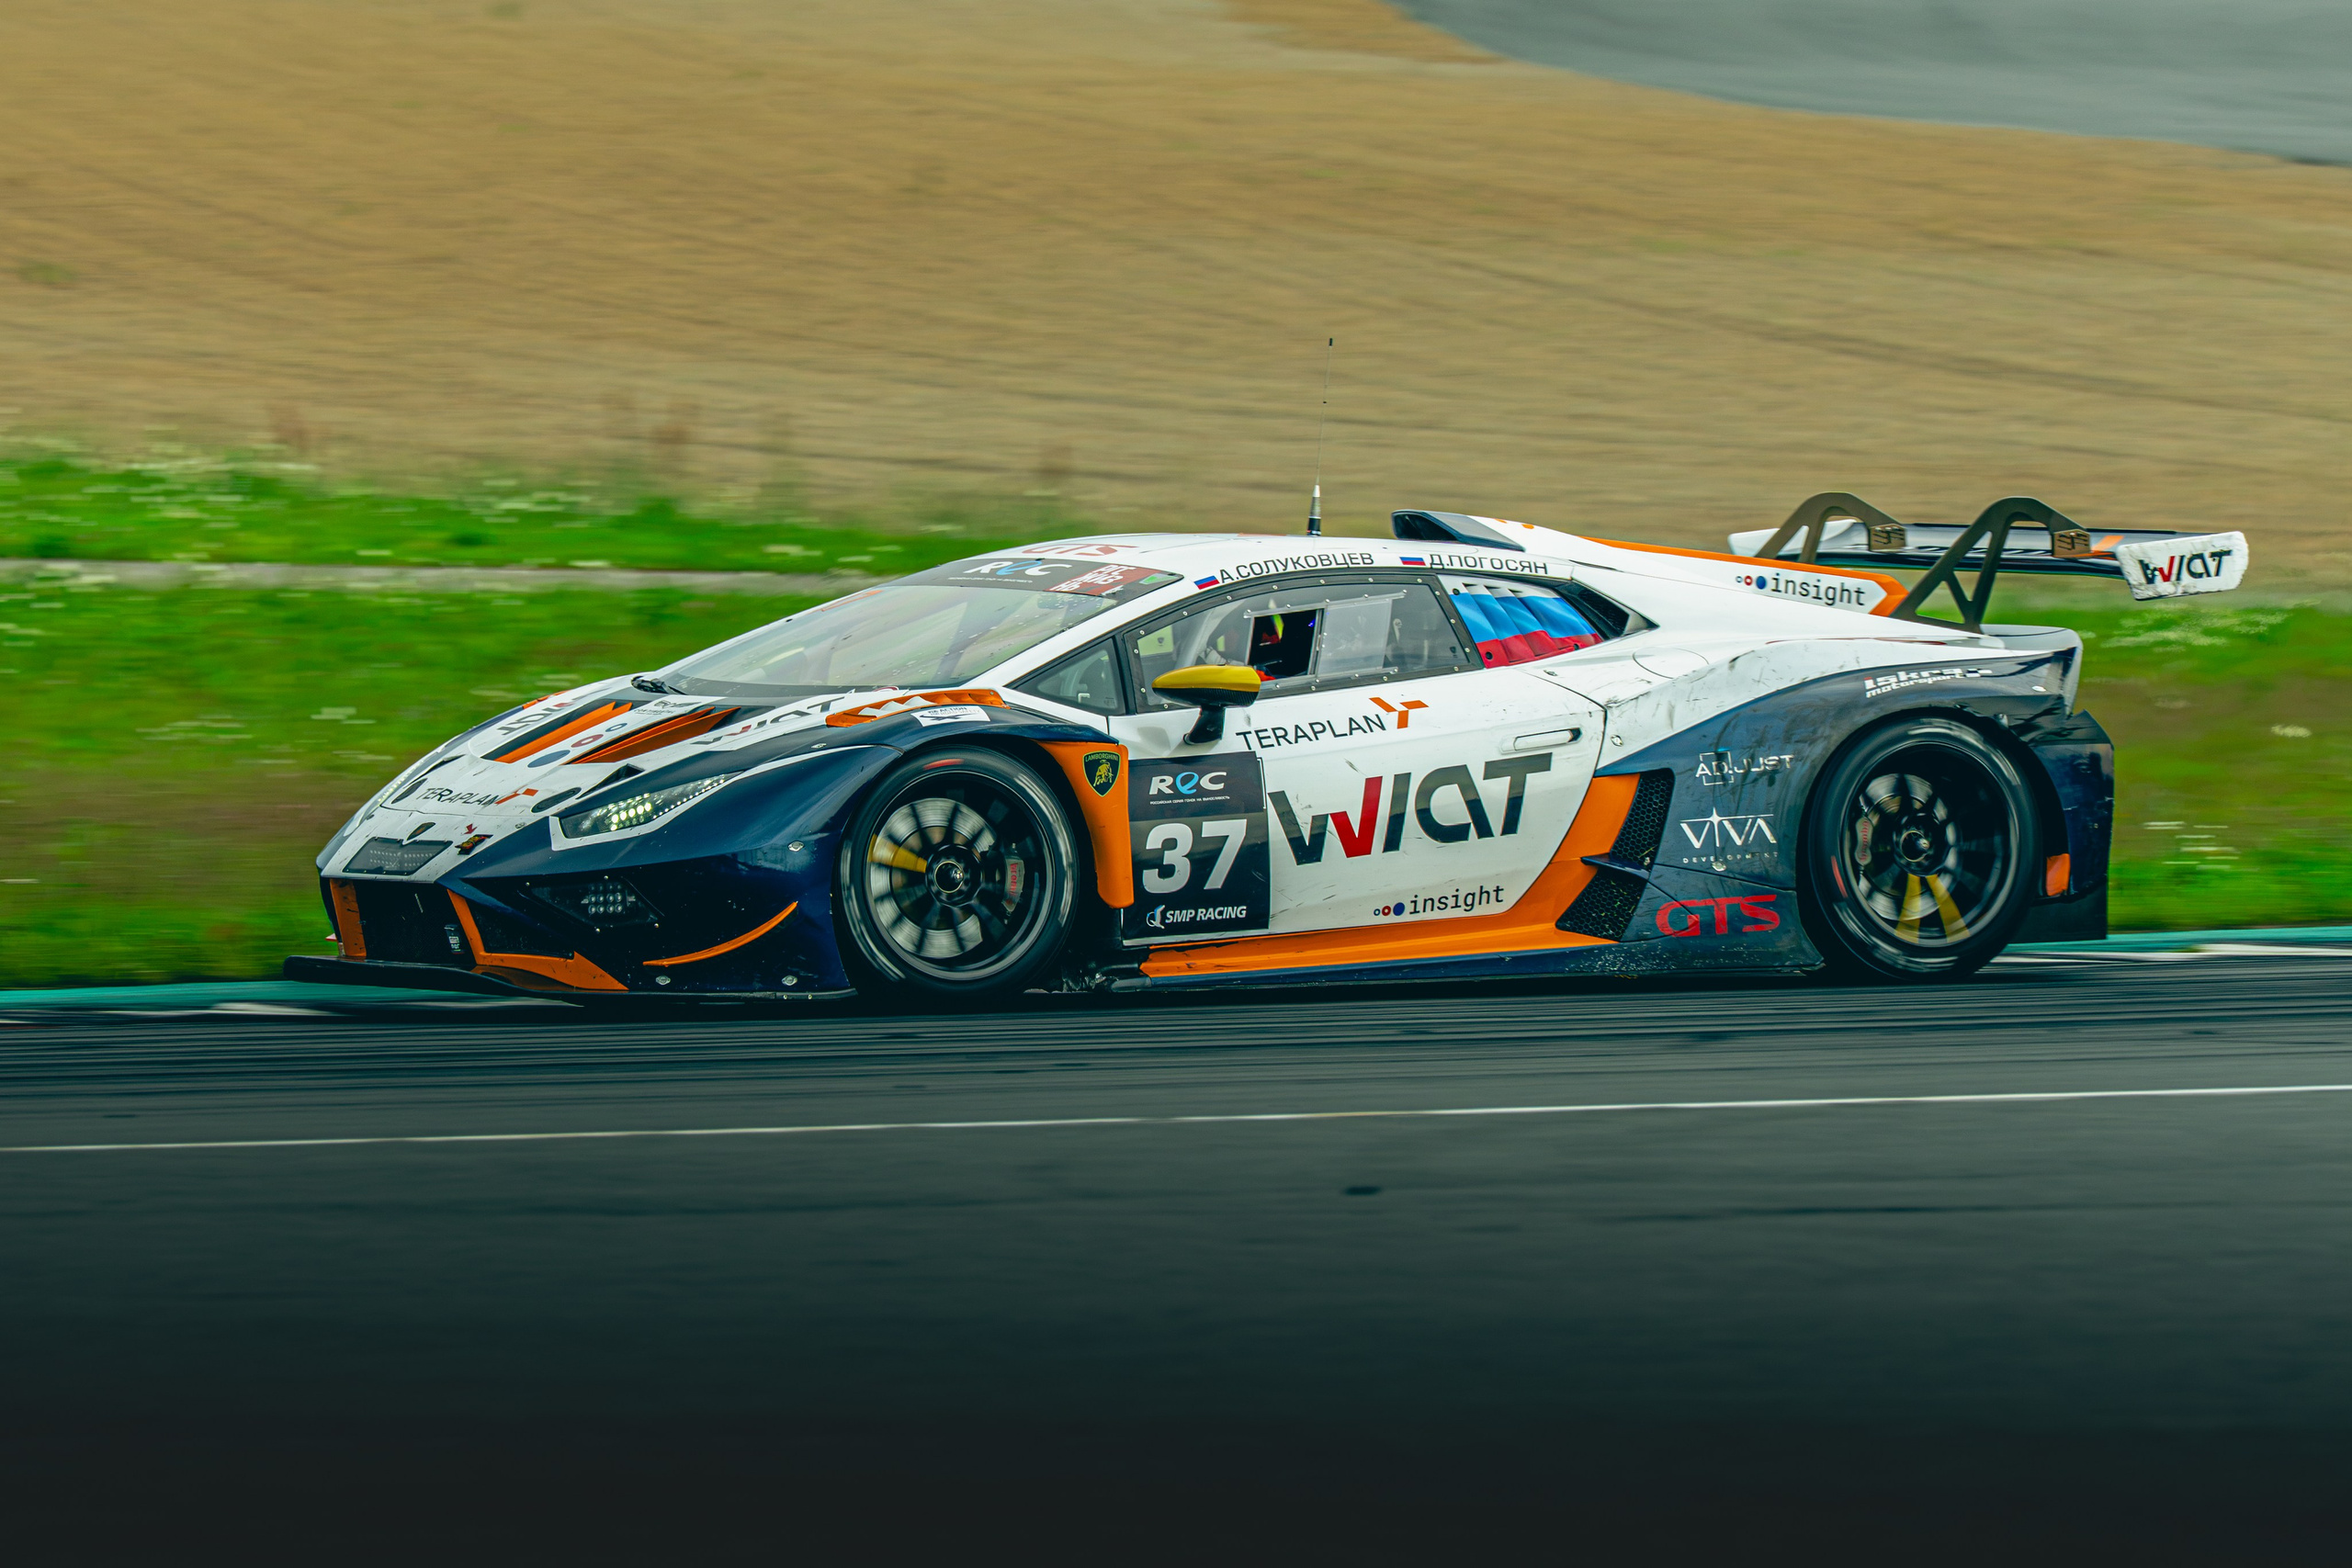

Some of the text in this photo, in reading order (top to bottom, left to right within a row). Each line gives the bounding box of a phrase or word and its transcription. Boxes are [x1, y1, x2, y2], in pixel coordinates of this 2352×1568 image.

[1219, 552, 1374, 584] А.СОЛУКОВЦЕВ
[1429, 553, 1549, 575] Д.ПОГОСЯН
[2138, 549, 2233, 584] WIAT
[1770, 572, 1866, 606] insight
[1236, 714, 1386, 750] TERAPLAN
[1085, 753, 1118, 761] LAMBORGHINI
[416, 787, 500, 806] TERAPLAN
[1268, 751, 1553, 866] WIAT
[1680, 807, 1777, 849] VIVA
[1142, 818, 1247, 894] 37
[1165, 906, 1247, 923] SMP RACING
[1408, 886, 1505, 916] insight
[1655, 895, 1781, 937] GTS
